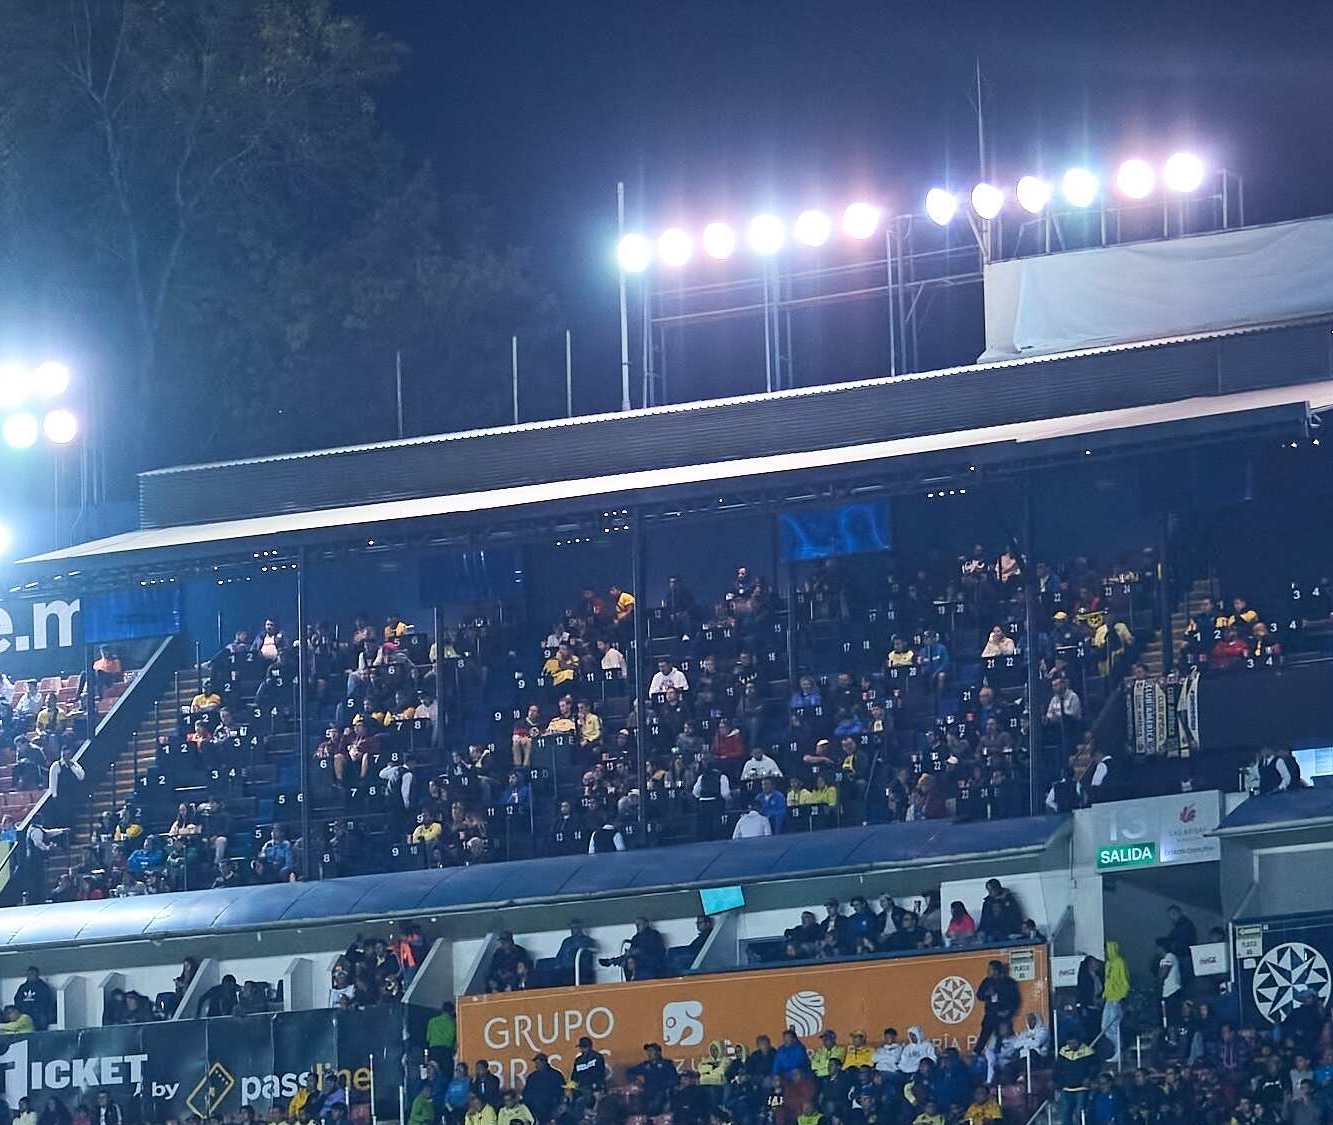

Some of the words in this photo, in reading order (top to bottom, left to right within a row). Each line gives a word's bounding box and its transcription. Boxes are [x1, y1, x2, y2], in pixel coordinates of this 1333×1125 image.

[1294, 590, 1300, 599] 3
[1011, 624, 1017, 632] 21
[1271, 623, 1277, 632] 3
[1194, 633, 1200, 641] 1
[1214, 630, 1221, 639] 2
[844, 643, 850, 651] 17
[544, 650, 550, 658] 9
[988, 660, 994, 668] 21
[1007, 658, 1013, 666] 22
[1248, 659, 1254, 668] 3
[1266, 657, 1272, 665] 4
[388, 666, 395, 674] 6
[891, 669, 897, 677] 19
[587, 673, 594, 681] 11
[606, 671, 612, 679] 12
[277, 678, 282, 686] 3
[519, 680, 525, 688] 9
[538, 678, 544, 686] 10
[225, 683, 230, 691] 2
[658, 695, 664, 703] 13
[964, 692, 970, 700] 21
[348, 699, 354, 707] 5
[255, 709, 261, 717] 3
[271, 707, 277, 715] 4
[514, 710, 520, 718] 10
[184, 716, 190, 724] 1
[203, 714, 208, 722] 2
[495, 712, 501, 720] 9
[396, 722, 402, 730] 7
[415, 721, 421, 729] 8
[326, 729, 331, 737] 5
[234, 738, 240, 746] 3
[538, 739, 544, 747] 11
[556, 737, 563, 745] 12
[181, 744, 187, 752] 2
[374, 755, 379, 763] 7
[392, 753, 398, 761] 8
[320, 760, 326, 768] 6
[934, 761, 940, 770] 22
[212, 771, 218, 779] 3
[531, 770, 537, 778] 12
[159, 776, 165, 784] 2
[369, 787, 376, 795] 8
[279, 795, 285, 803] 5
[298, 794, 303, 802] 6
[488, 808, 494, 816] 11
[507, 806, 513, 814] 12
[417, 813, 424, 823] 9
[722, 815, 727, 824] 17
[256, 830, 261, 838] 5
[557, 833, 562, 841] 13
[575, 831, 581, 839] 14
[167, 838, 173, 846] 3
[392, 848, 398, 856] 9
[1100, 846, 1153, 864] SALIDA
[324, 854, 330, 862] 8
[484, 1006, 615, 1051] GRUPO
[151, 1080, 180, 1101] by
